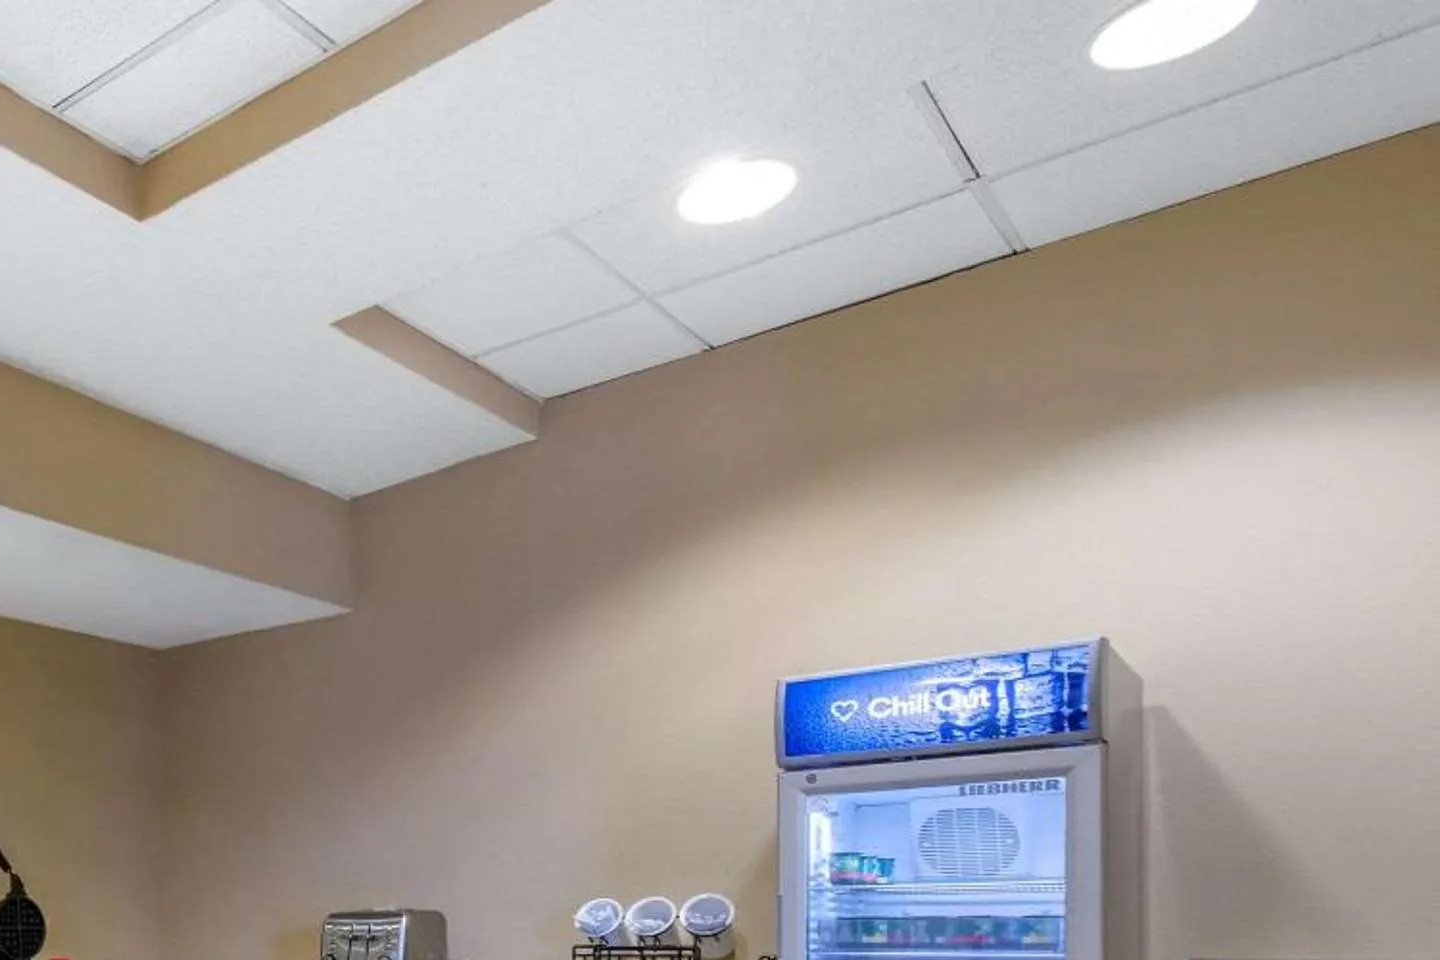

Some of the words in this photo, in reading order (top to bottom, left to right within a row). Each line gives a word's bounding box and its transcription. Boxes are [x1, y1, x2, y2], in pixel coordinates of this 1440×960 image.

[867, 691, 931, 718] Chill
[936, 686, 991, 713] Out
[958, 778, 1062, 797] LIEBHERR
